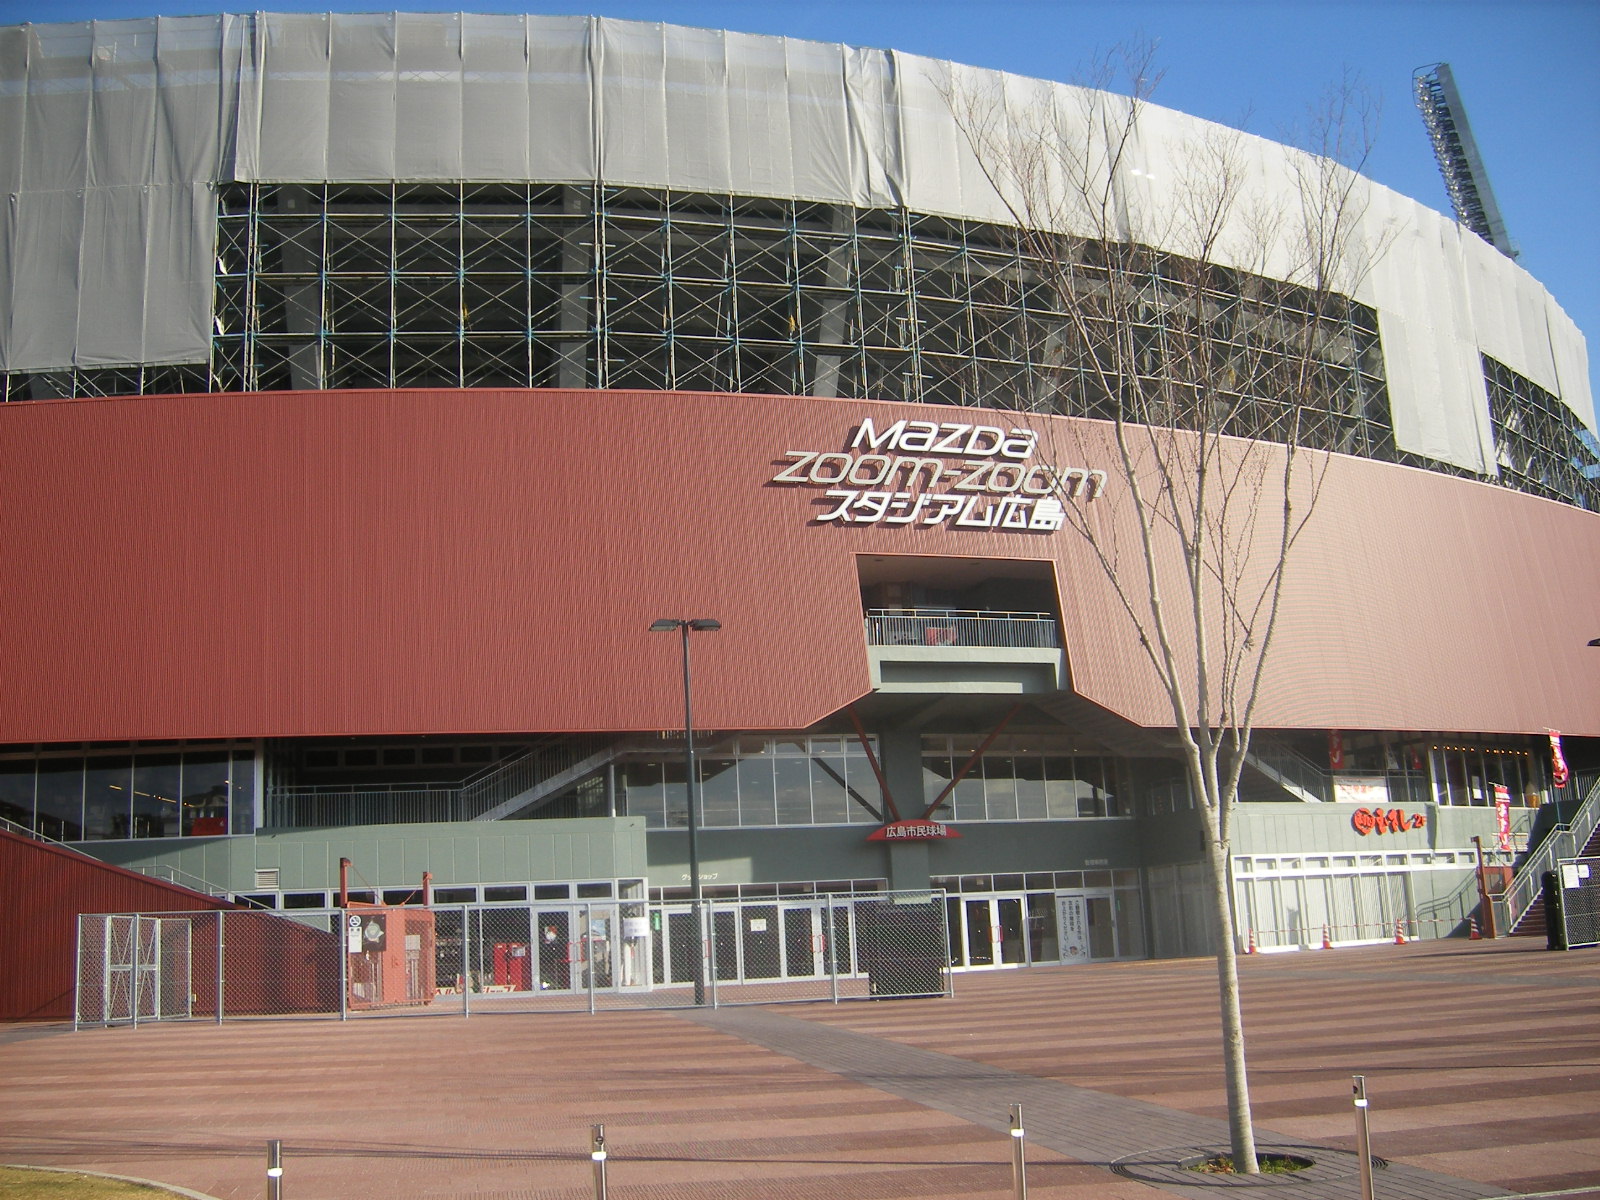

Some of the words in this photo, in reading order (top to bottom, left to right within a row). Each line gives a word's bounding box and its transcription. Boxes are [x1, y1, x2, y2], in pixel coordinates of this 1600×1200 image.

[816, 490, 1066, 531] スタジアム広島
[886, 825, 947, 838] 広島市民球場
